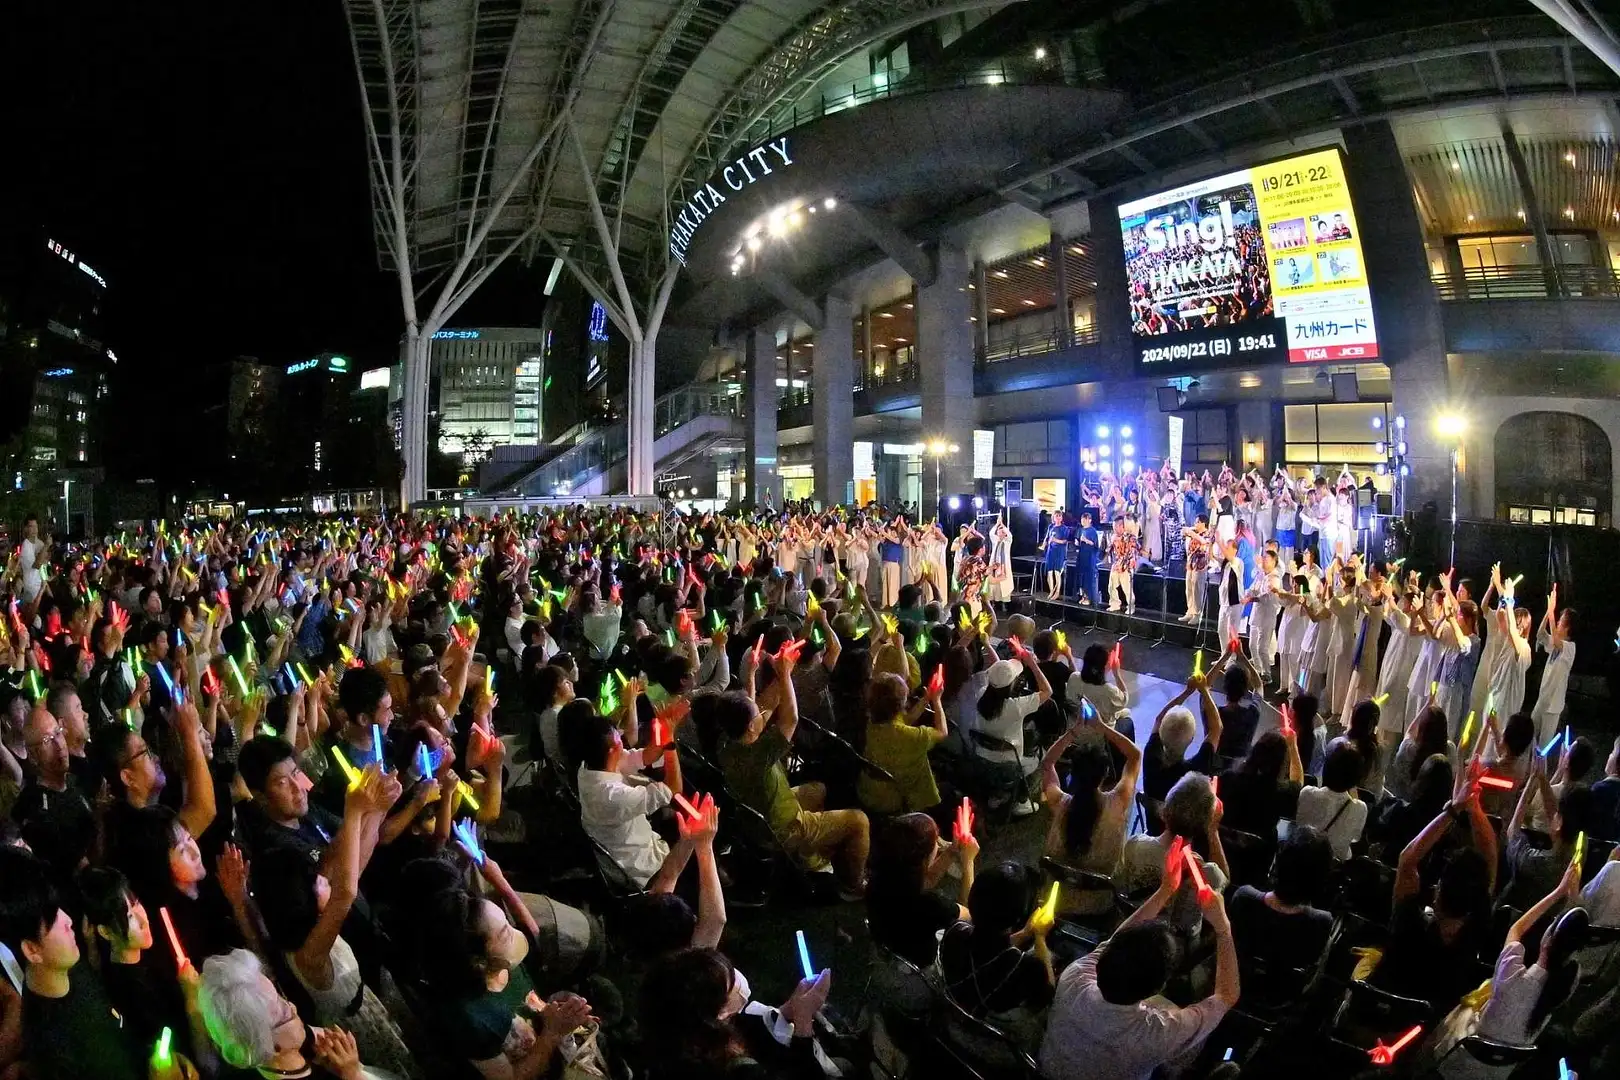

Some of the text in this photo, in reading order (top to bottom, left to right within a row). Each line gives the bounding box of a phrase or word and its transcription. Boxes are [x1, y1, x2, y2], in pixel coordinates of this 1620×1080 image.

[671, 183, 726, 251] HAKATA
[723, 137, 793, 192] CITY
[1145, 200, 1237, 253] Sing!
[1149, 250, 1242, 293] HAKATA
[1238, 334, 1277, 351] 19:41
[1294, 317, 1368, 340] 九州カード
[1303, 346, 1365, 360] VISA JCB
